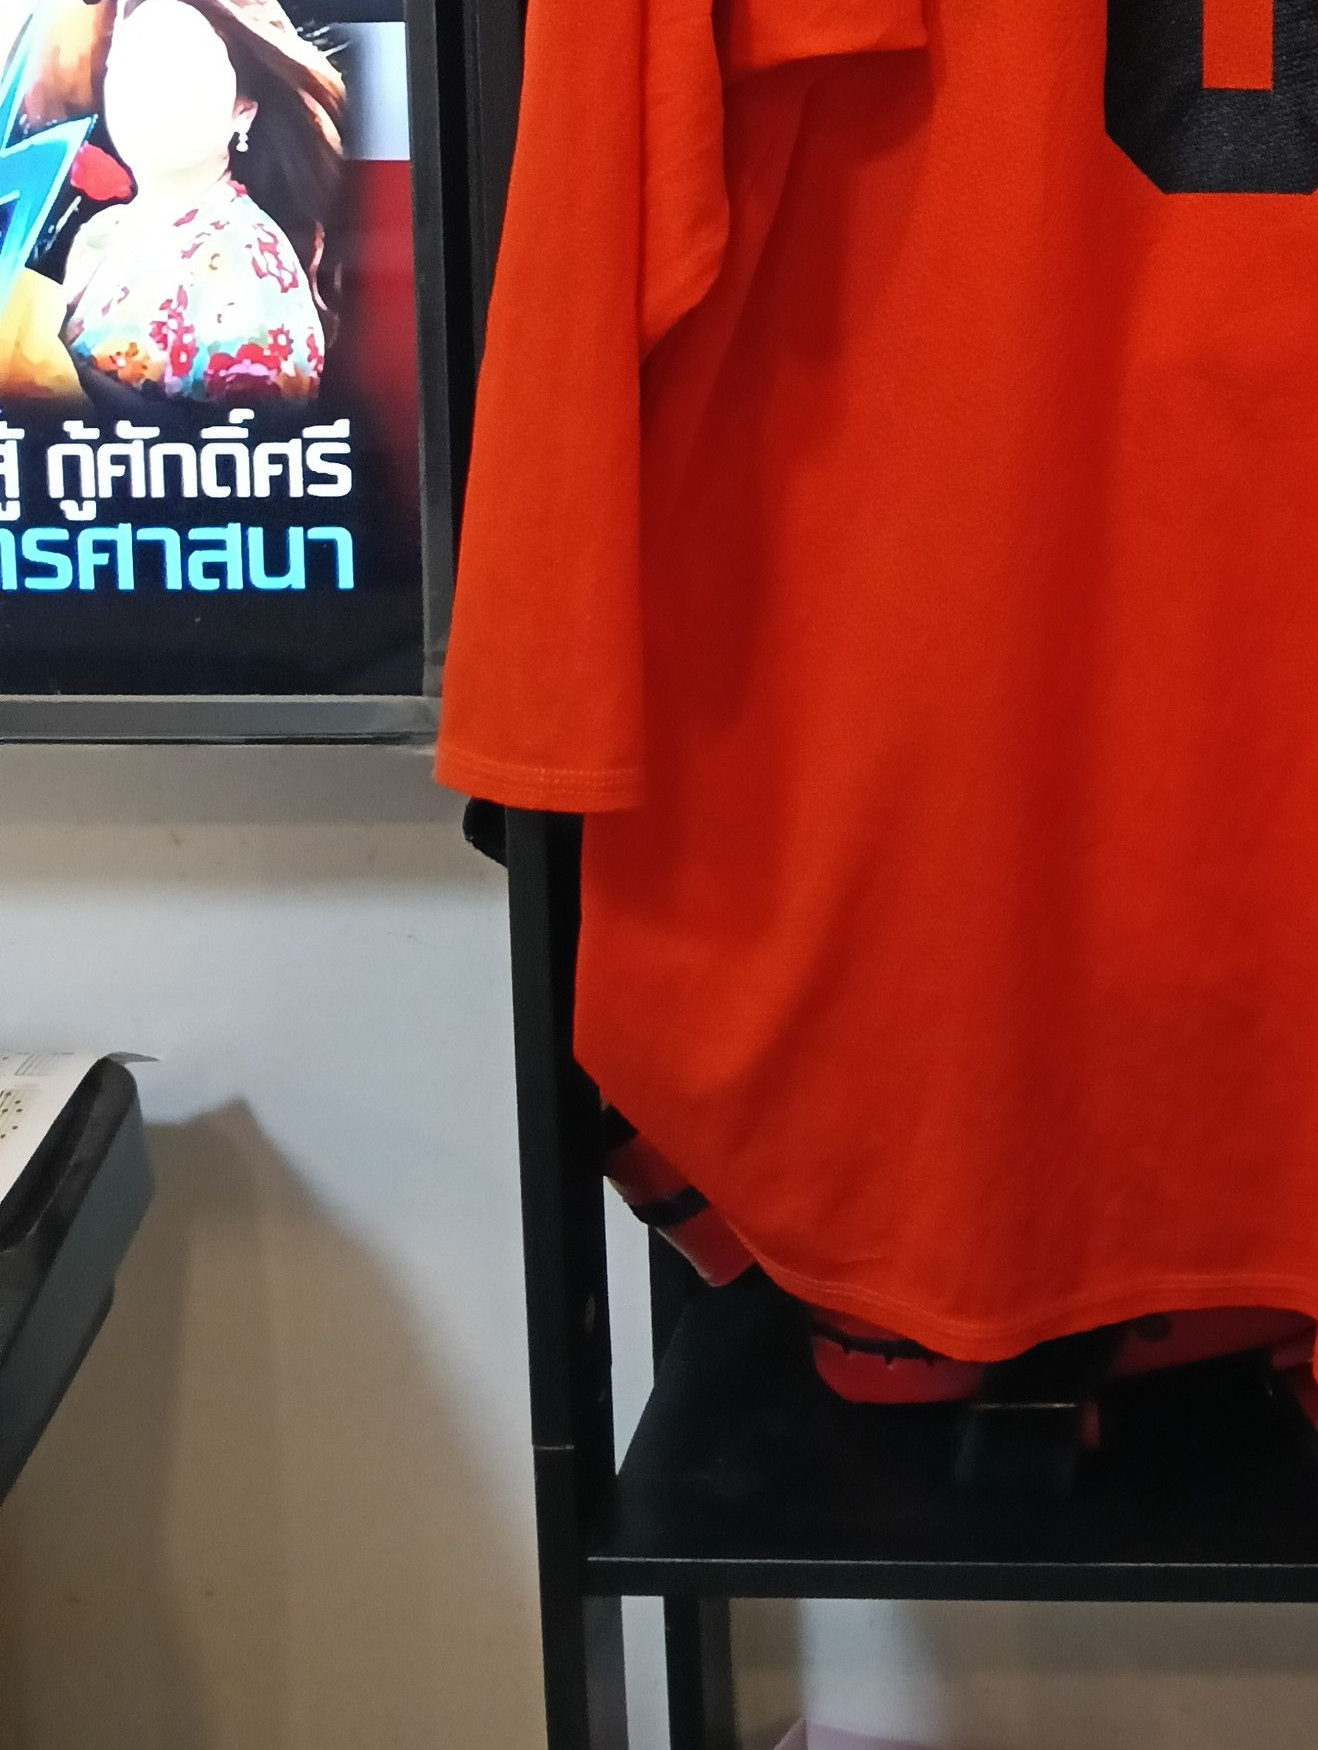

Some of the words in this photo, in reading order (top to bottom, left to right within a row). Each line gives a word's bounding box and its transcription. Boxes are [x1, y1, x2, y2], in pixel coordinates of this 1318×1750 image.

[47, 408, 353, 521] กู้ศักดิ์ศรี
